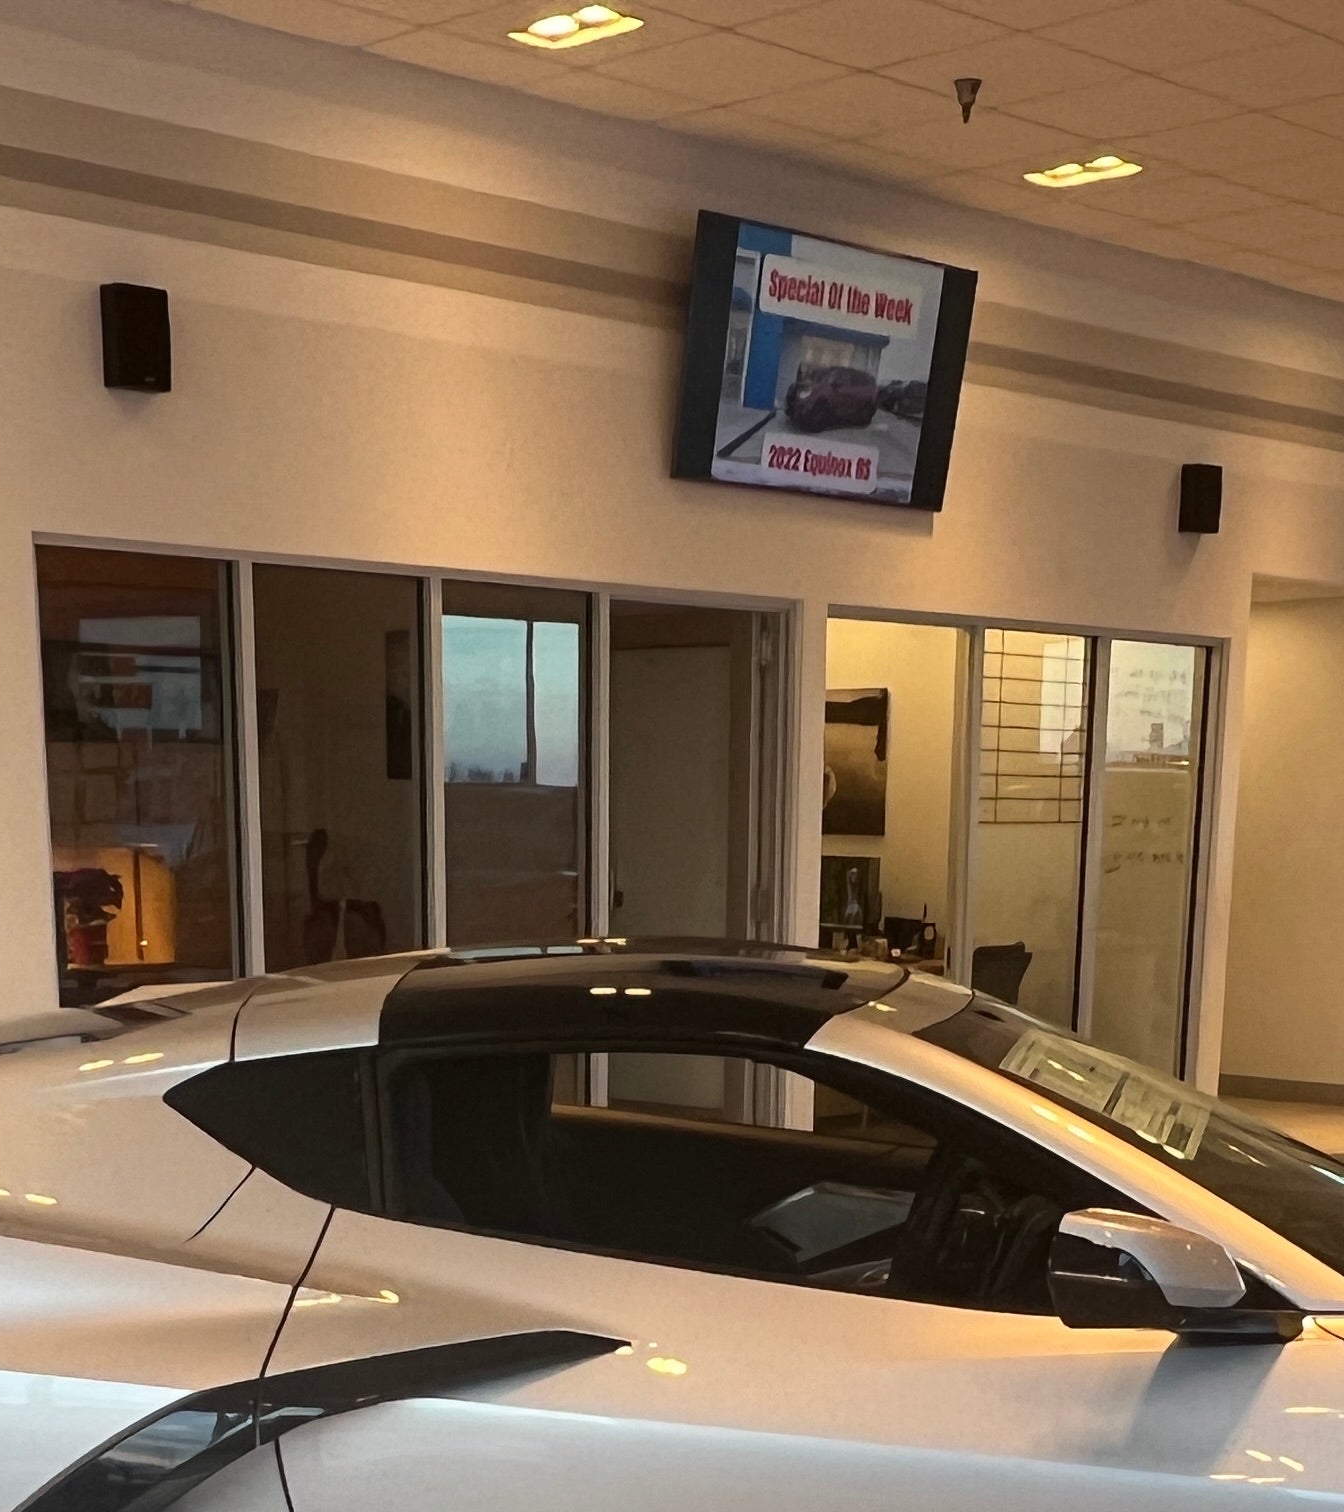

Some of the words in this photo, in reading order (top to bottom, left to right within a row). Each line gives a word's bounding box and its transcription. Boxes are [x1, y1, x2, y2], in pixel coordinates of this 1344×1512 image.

[768, 268, 825, 307] Special
[847, 285, 871, 315] the
[874, 291, 914, 325] Week
[768, 444, 801, 471] 2022
[803, 448, 852, 478] Equinox
